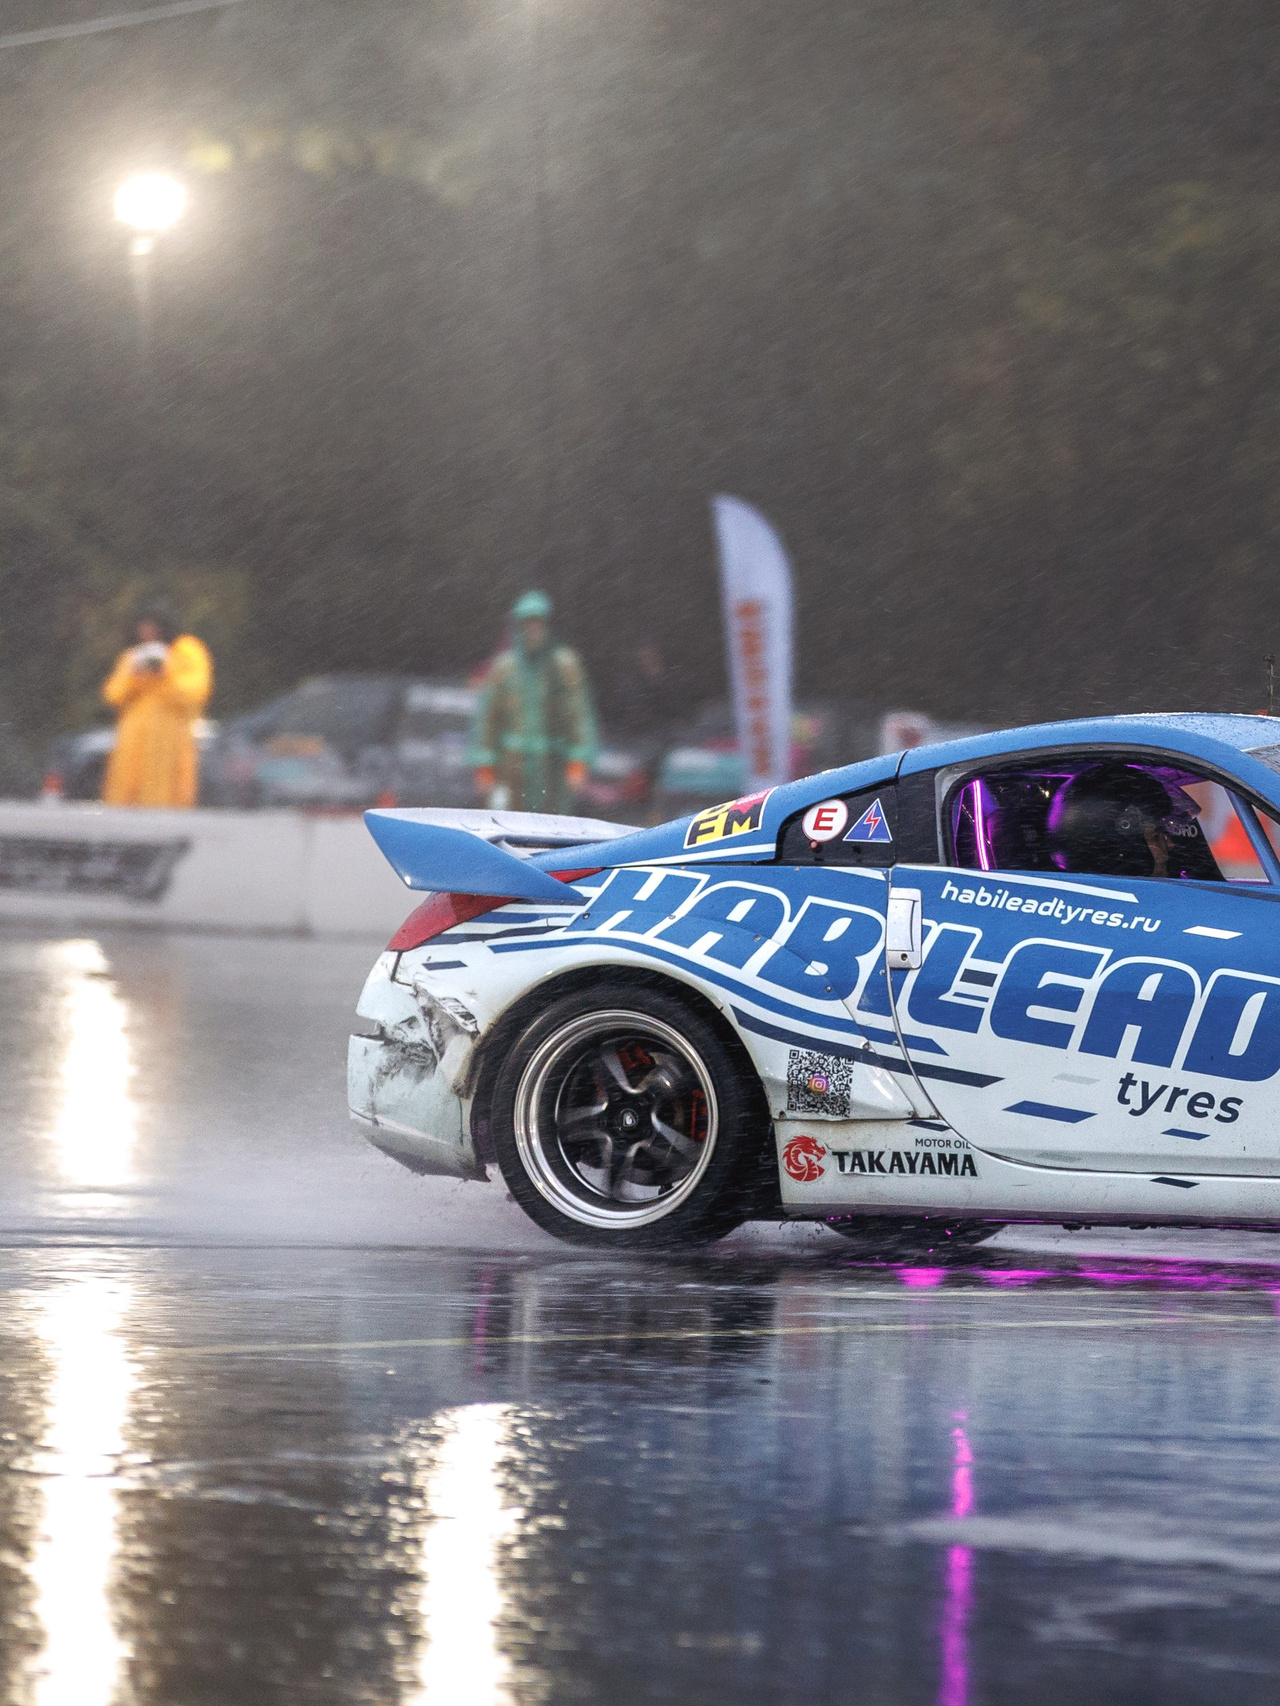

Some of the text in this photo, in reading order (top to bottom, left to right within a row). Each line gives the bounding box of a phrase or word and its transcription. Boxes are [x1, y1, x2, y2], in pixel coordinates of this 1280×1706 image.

[813, 808, 838, 831] E
[940, 880, 1162, 933] habileadtyres.ru
[1117, 1072, 1244, 1124] tyres
[915, 1138, 971, 1149] MOTOR OIL
[832, 1151, 978, 1177] TAKAYAMA
